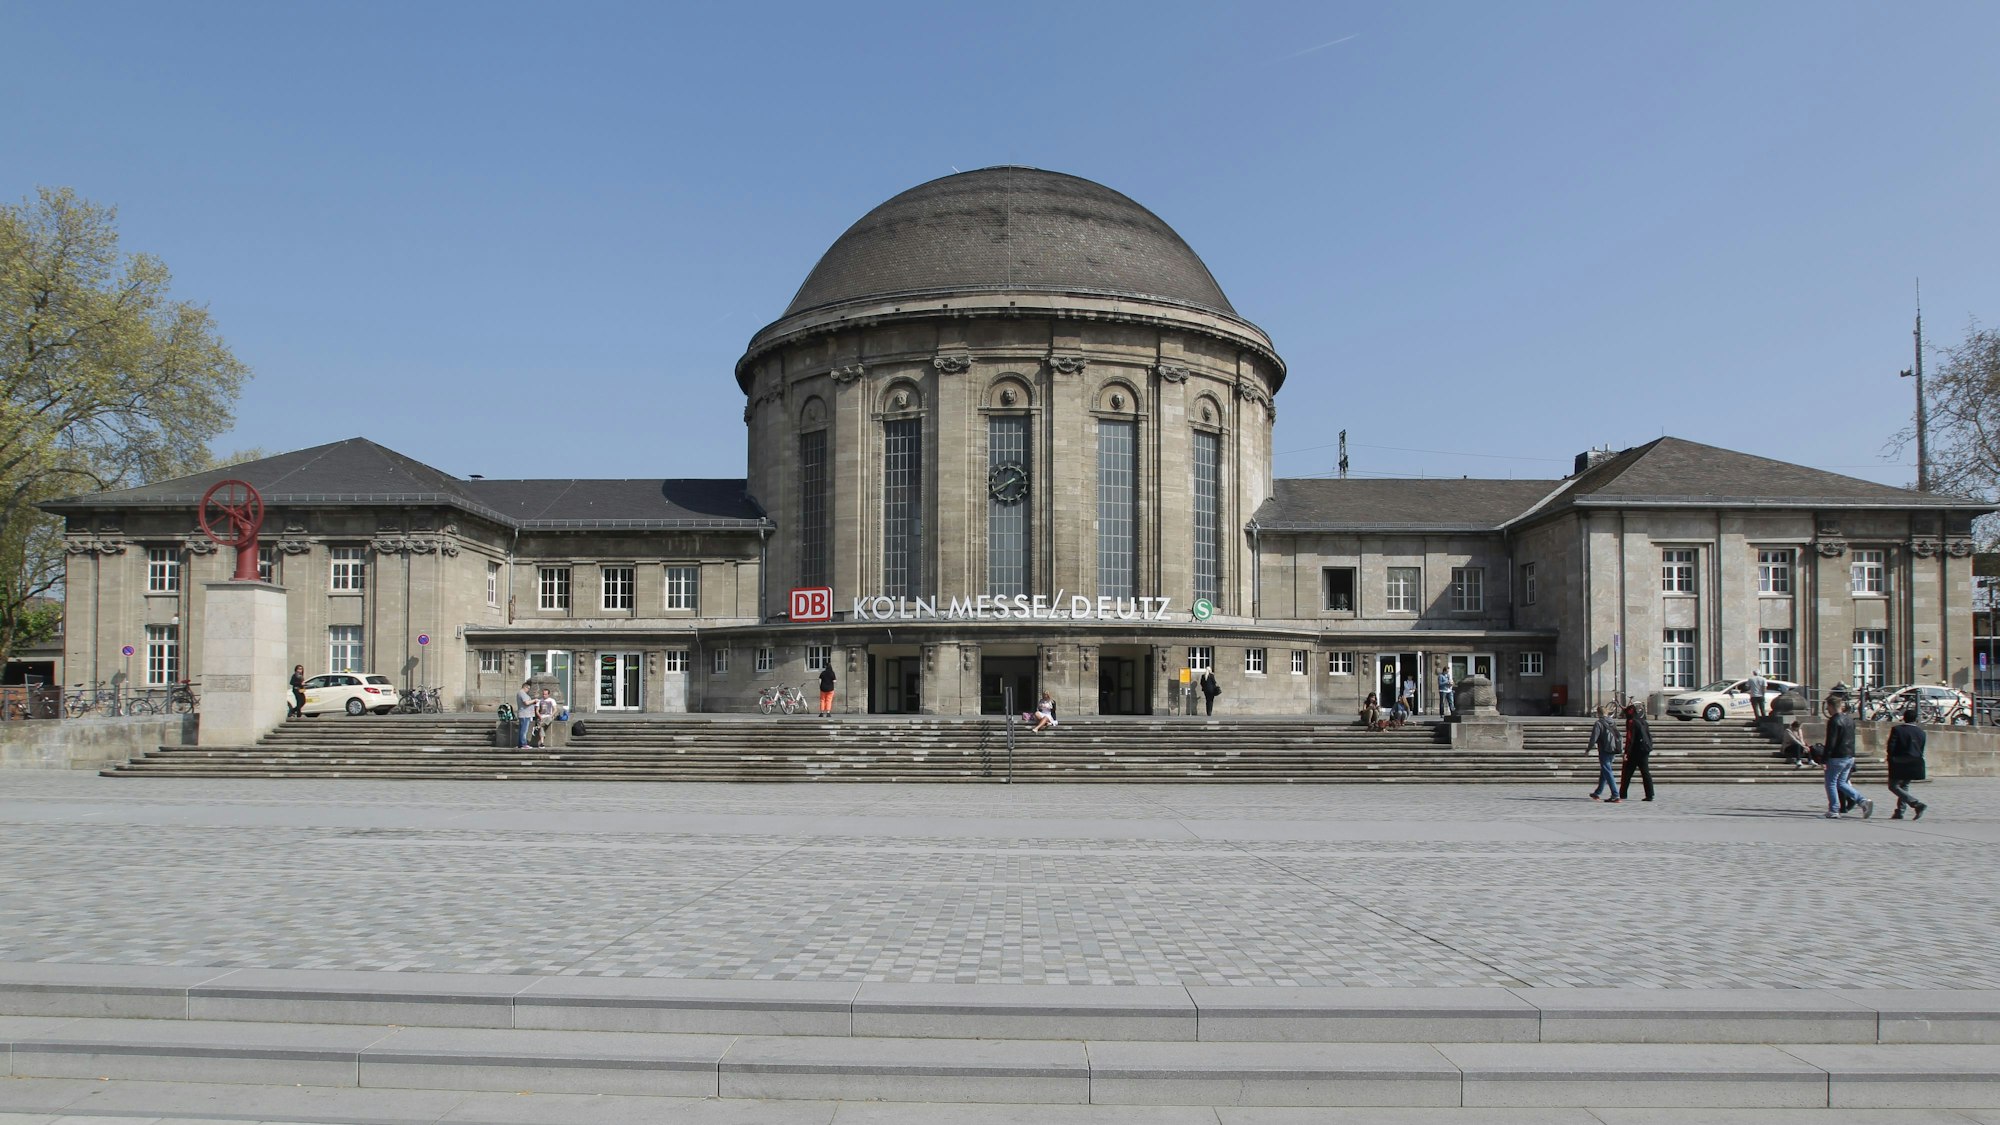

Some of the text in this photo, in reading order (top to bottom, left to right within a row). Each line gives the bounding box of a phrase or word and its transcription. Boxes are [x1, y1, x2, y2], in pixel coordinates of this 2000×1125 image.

[794, 592, 826, 617] DB
[853, 595, 937, 620] KÖLN
[1196, 600, 1211, 619] S
